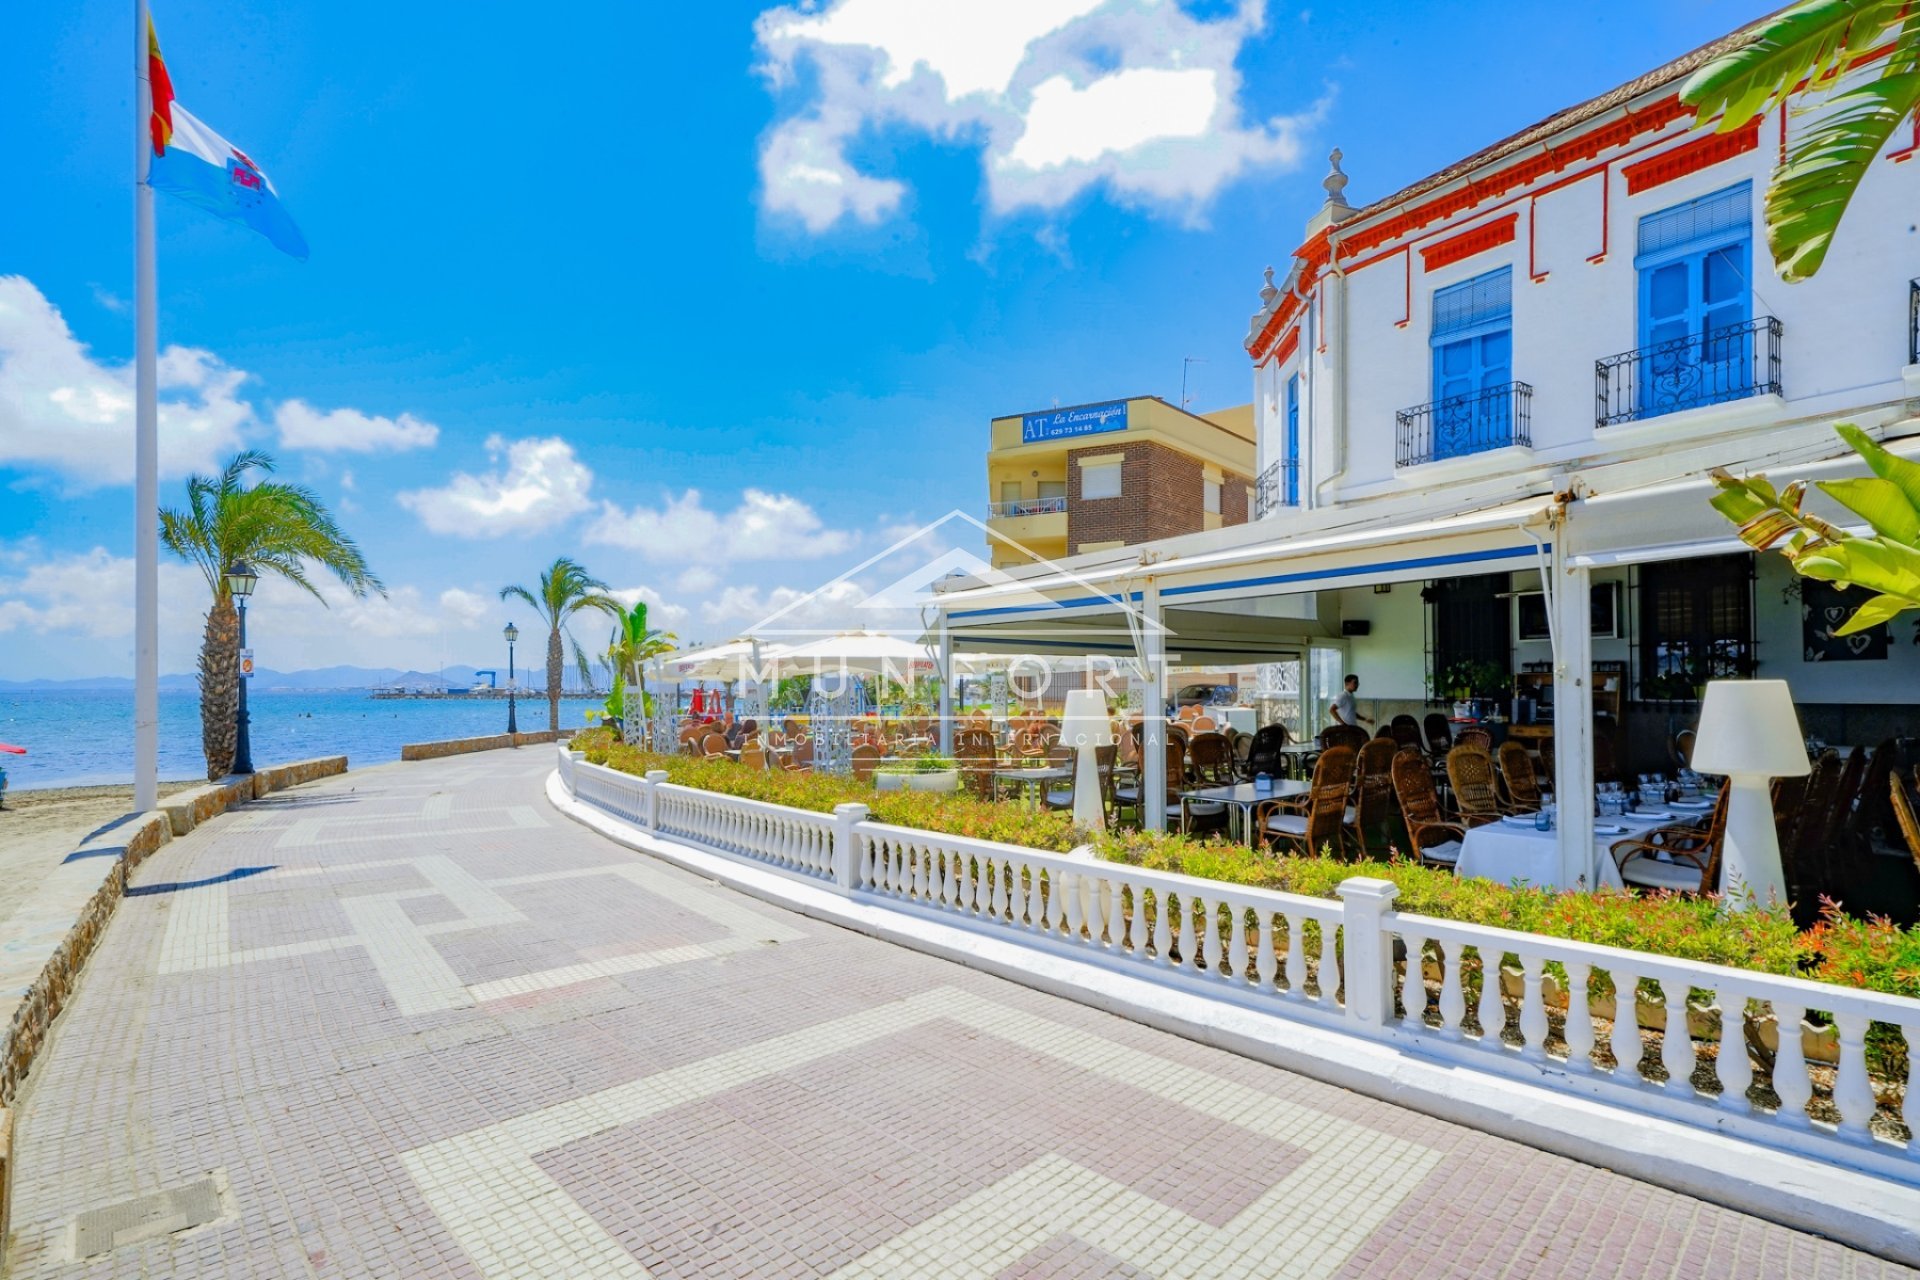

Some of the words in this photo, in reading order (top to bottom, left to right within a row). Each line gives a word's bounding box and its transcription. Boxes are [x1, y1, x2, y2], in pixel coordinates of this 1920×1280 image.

[1053, 414, 1066, 424] La
[1068, 407, 1121, 422] Encarnación
[1024, 418, 1048, 439] AT
